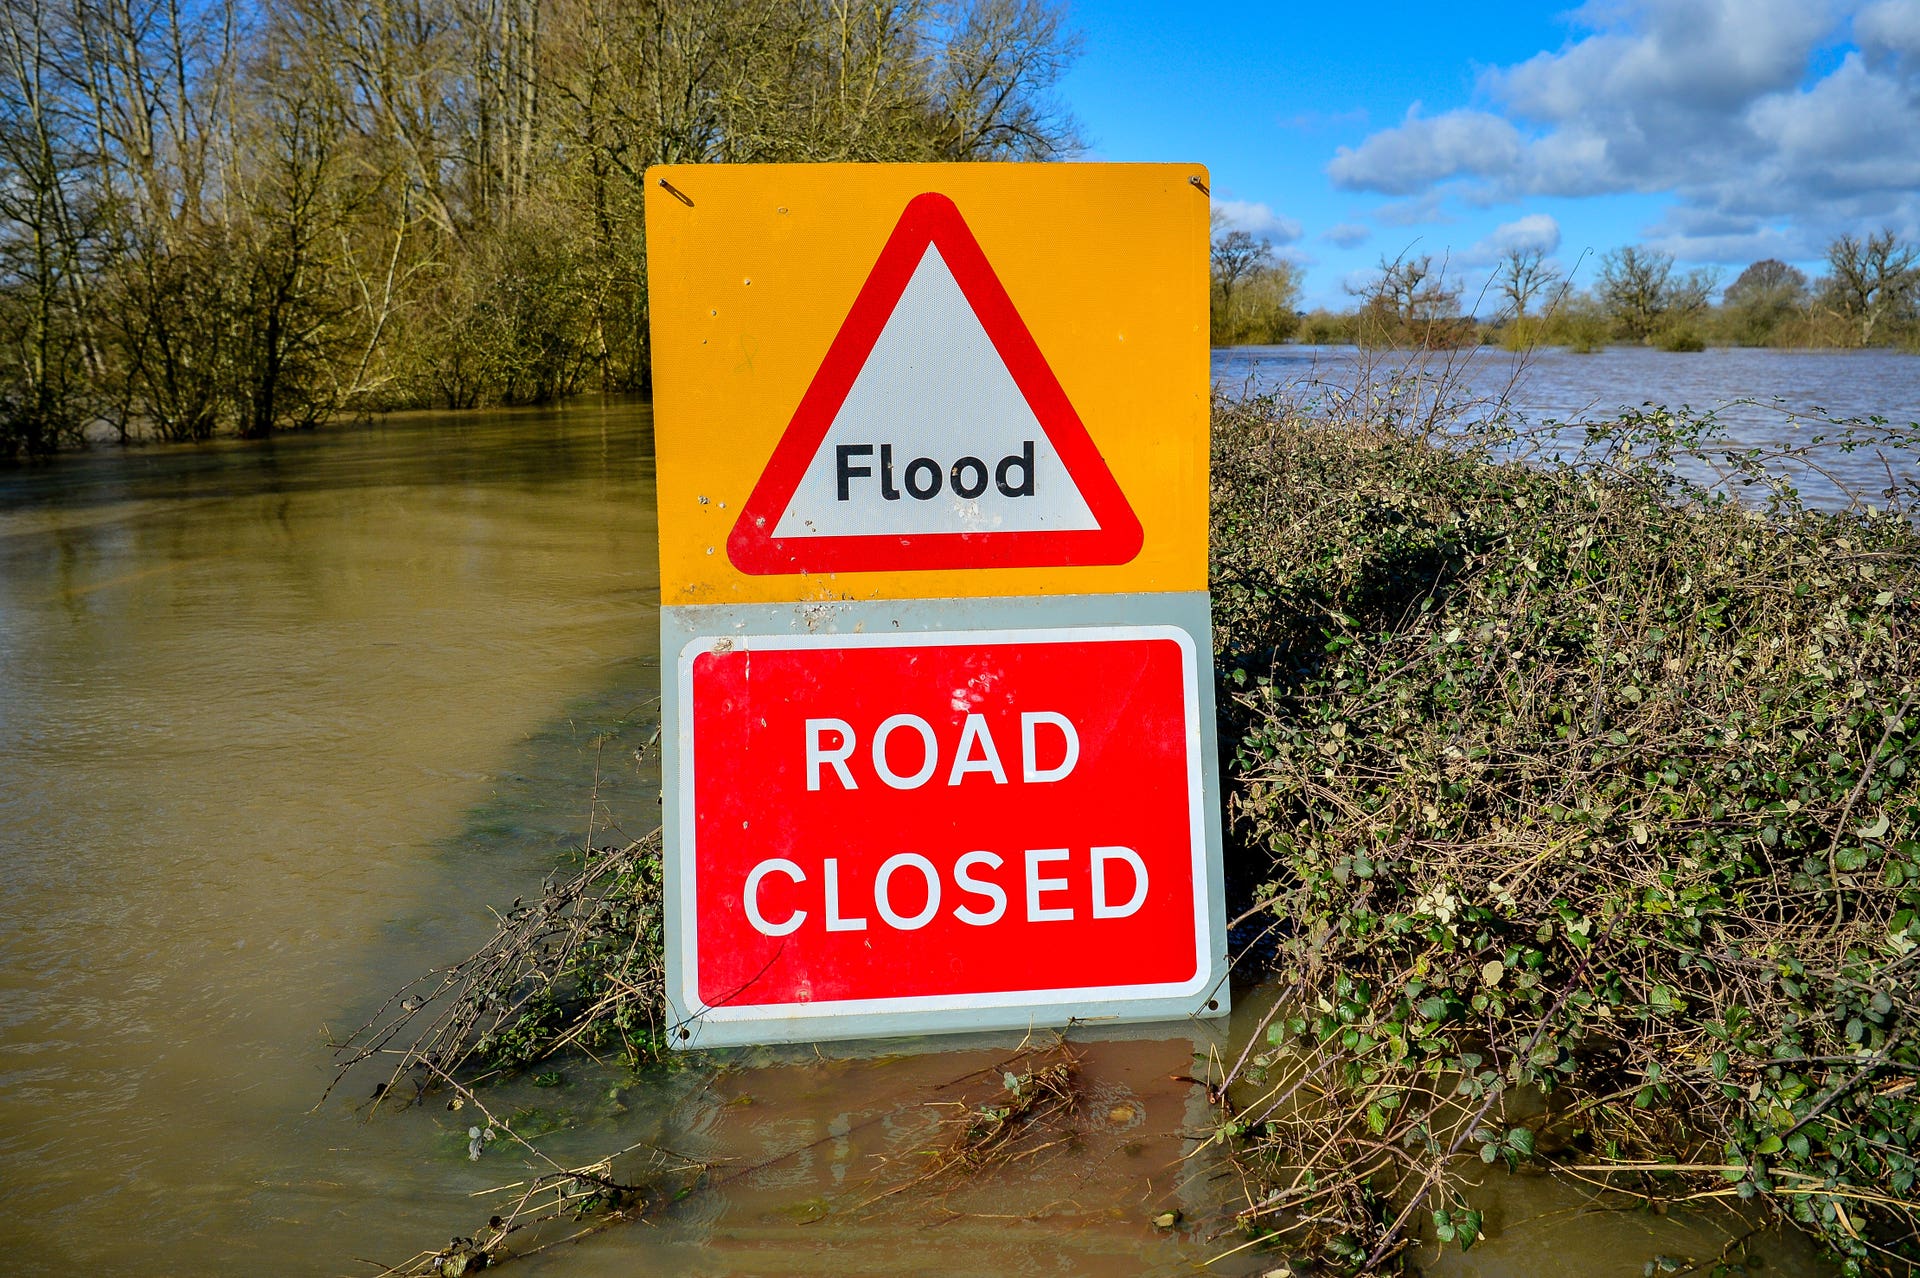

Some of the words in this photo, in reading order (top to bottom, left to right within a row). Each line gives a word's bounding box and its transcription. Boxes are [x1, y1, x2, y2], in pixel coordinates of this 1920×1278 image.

[836, 441, 1035, 502] Flood
[805, 711, 1080, 791] ROAD
[743, 845, 1149, 937] CLOSED
